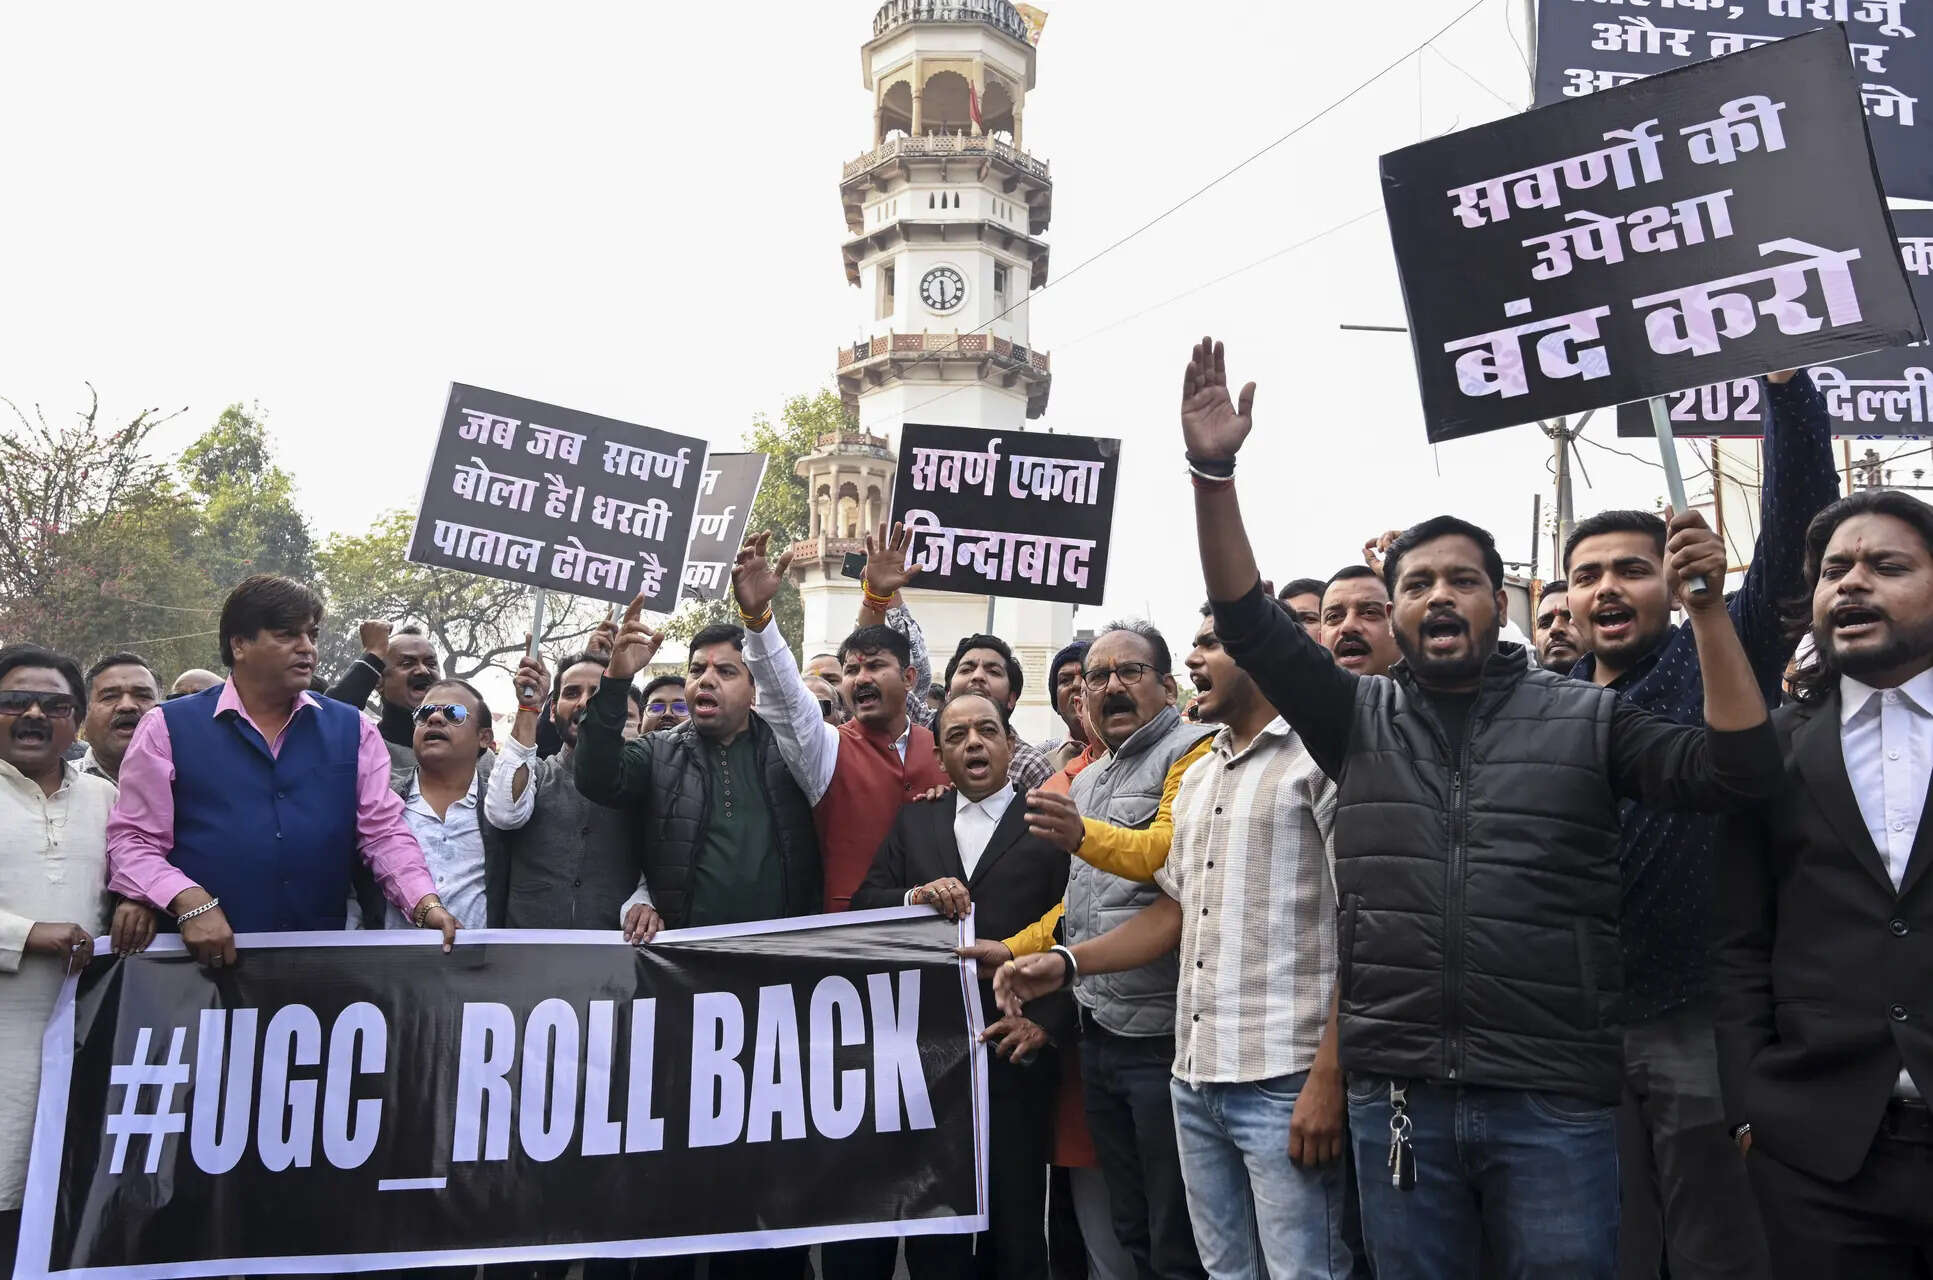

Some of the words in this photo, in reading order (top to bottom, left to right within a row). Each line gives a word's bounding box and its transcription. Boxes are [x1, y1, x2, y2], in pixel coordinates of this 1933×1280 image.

[1592, 15, 1696, 57] और
[1680, 95, 1786, 165] की
[1521, 189, 1734, 281] उपेक्षा
[1444, 297, 1612, 399] बंद
[1632, 237, 1863, 357] करो
[1669, 378, 1761, 421] 202
[1806, 366, 1933, 422] दिल्ली
[458, 408, 521, 450] जब
[525, 422, 587, 465] जब
[603, 439, 691, 489] सवर्ण
[911, 438, 1002, 496] सवर्ण
[1008, 455, 1105, 505] एकता
[452, 456, 539, 513] बोला
[591, 494, 673, 542] धरती
[433, 519, 546, 573] पाताल
[549, 536, 635, 592] ढोला
[639, 551, 668, 598] है
[902, 508, 1097, 590] जिन्दाबाद
[688, 968, 937, 1149] BACK
